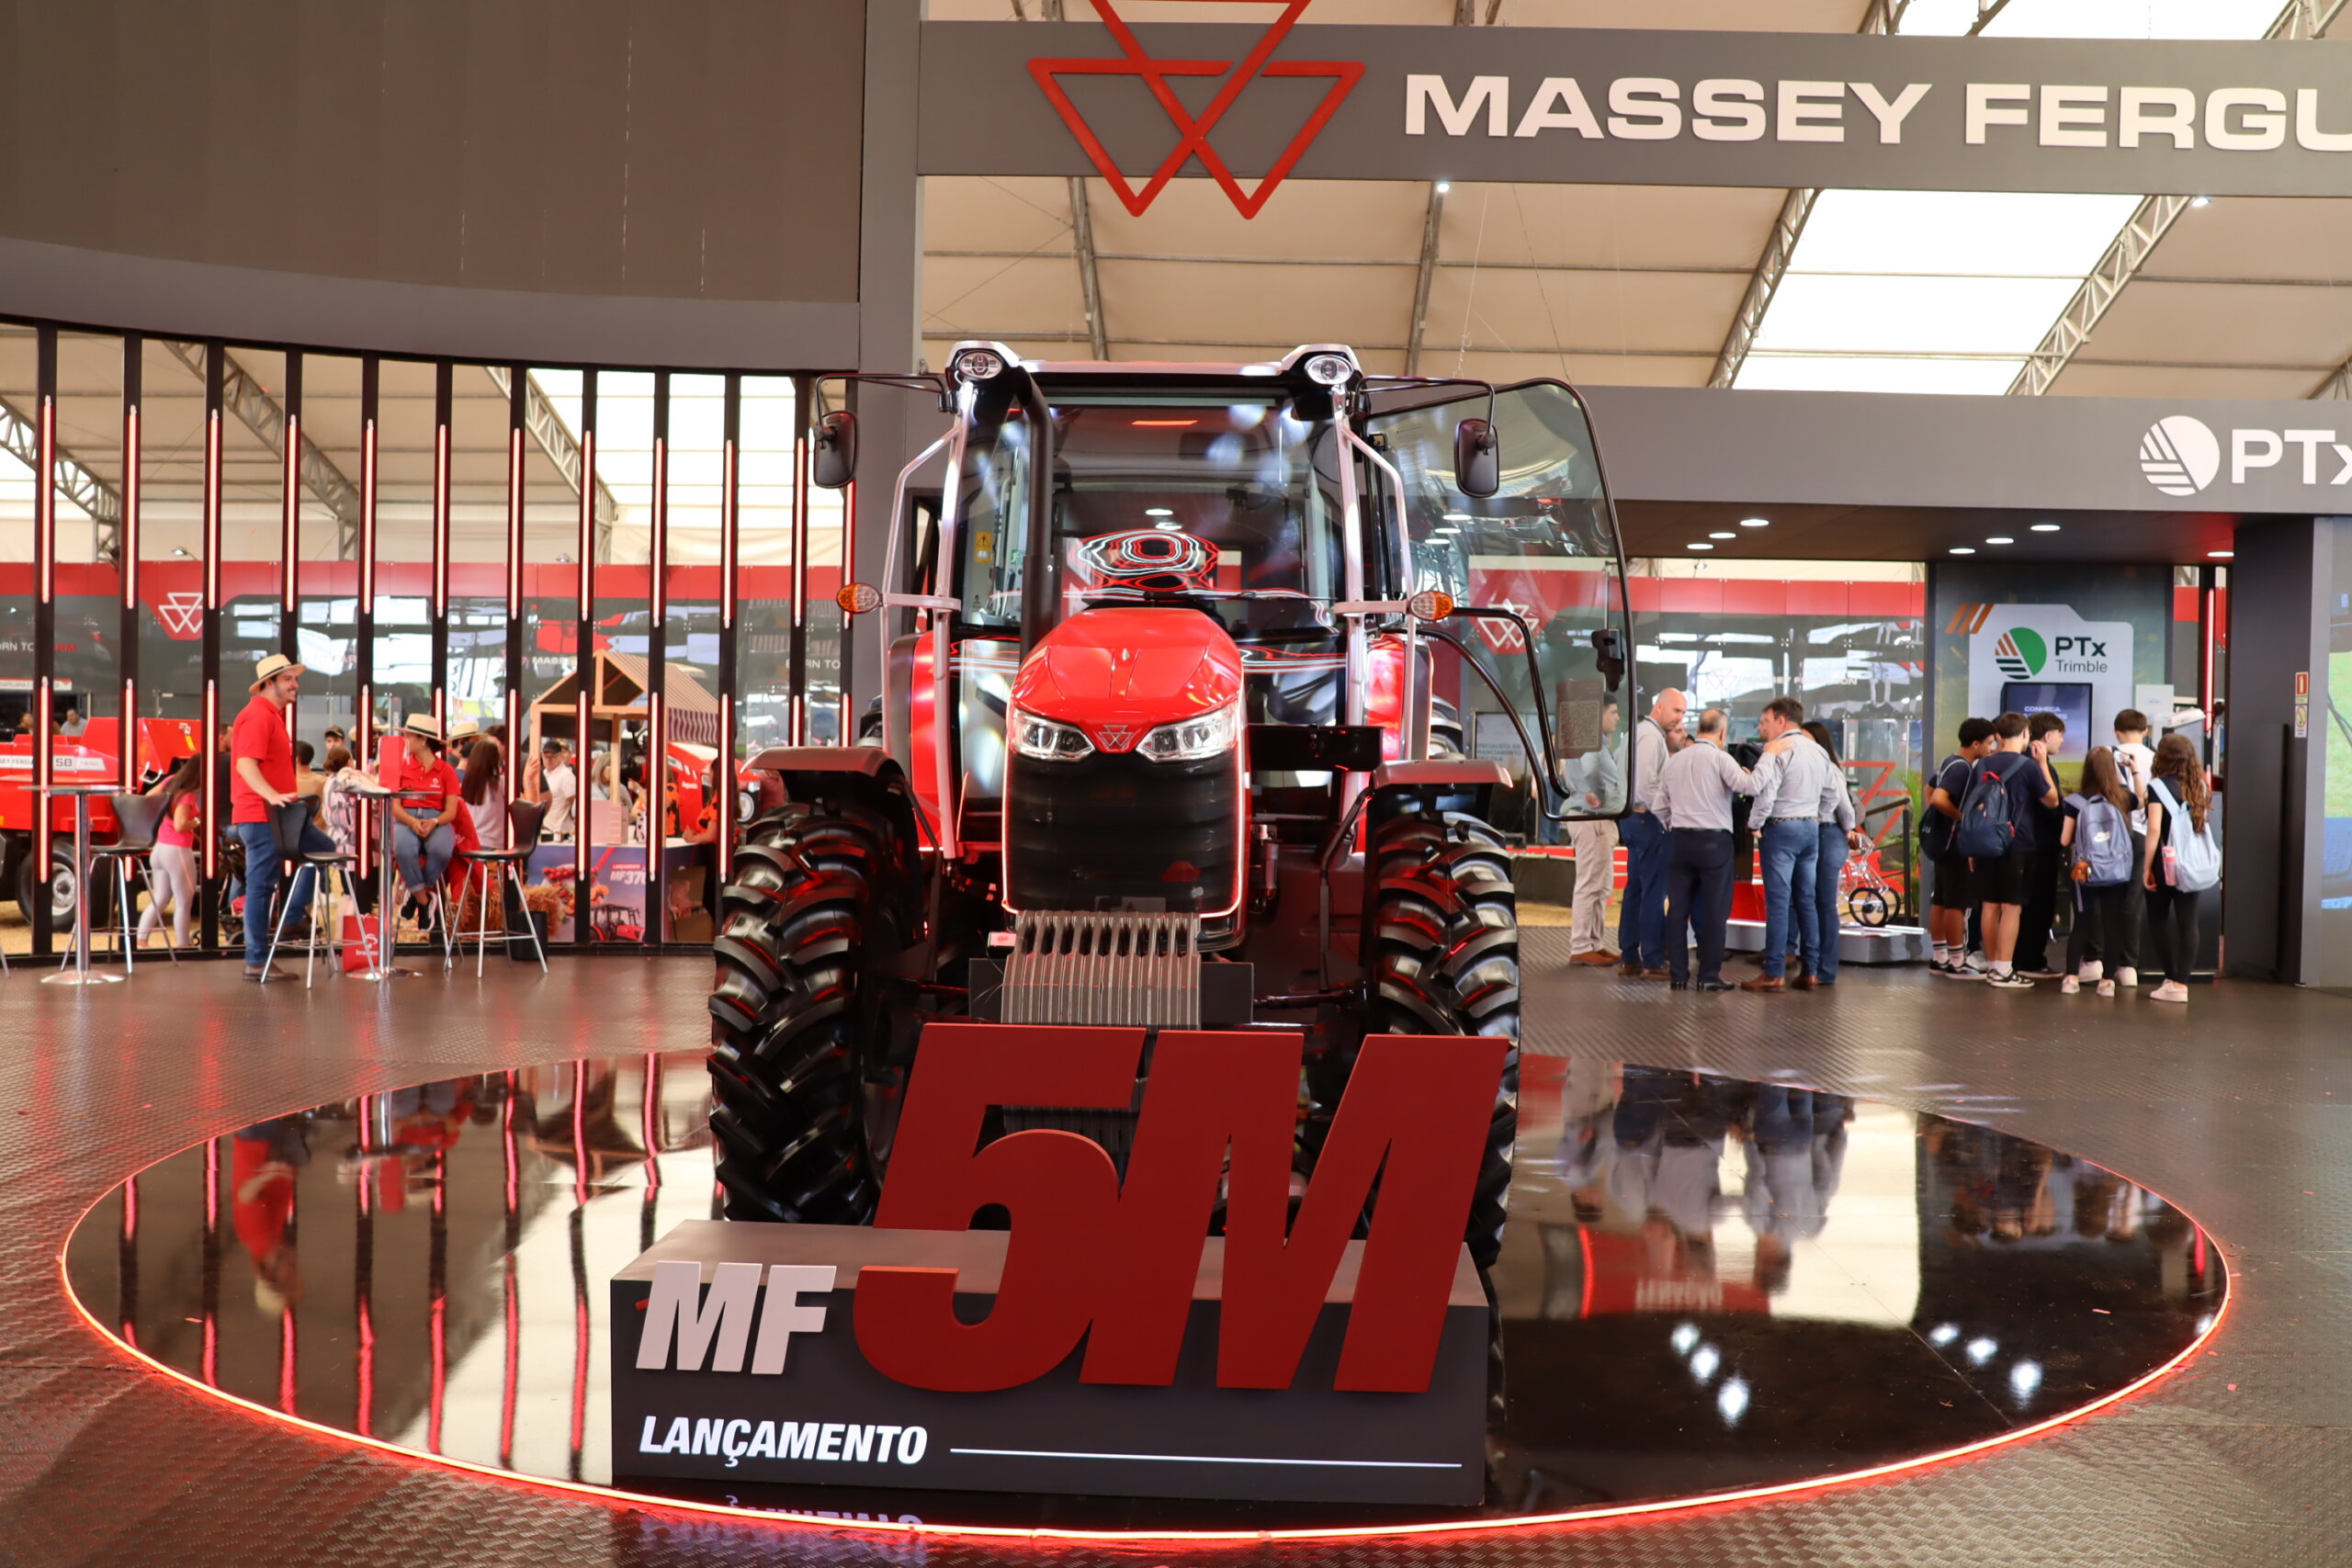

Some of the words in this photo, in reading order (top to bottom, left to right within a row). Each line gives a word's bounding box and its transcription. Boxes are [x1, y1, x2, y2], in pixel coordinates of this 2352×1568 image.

[1405, 73, 1932, 144] MASSEY
[1964, 83, 2352, 152] FERGU
[2055, 637, 2107, 657] PTx
[824, 659, 841, 670] TO
[2055, 660, 2108, 672] Trimble
[55, 758, 73, 767] SB
[635, 1260, 837, 1375] MF
[851, 1022, 1510, 1393] 5M
[639, 1415, 928, 1468] LANÇAMENTO
